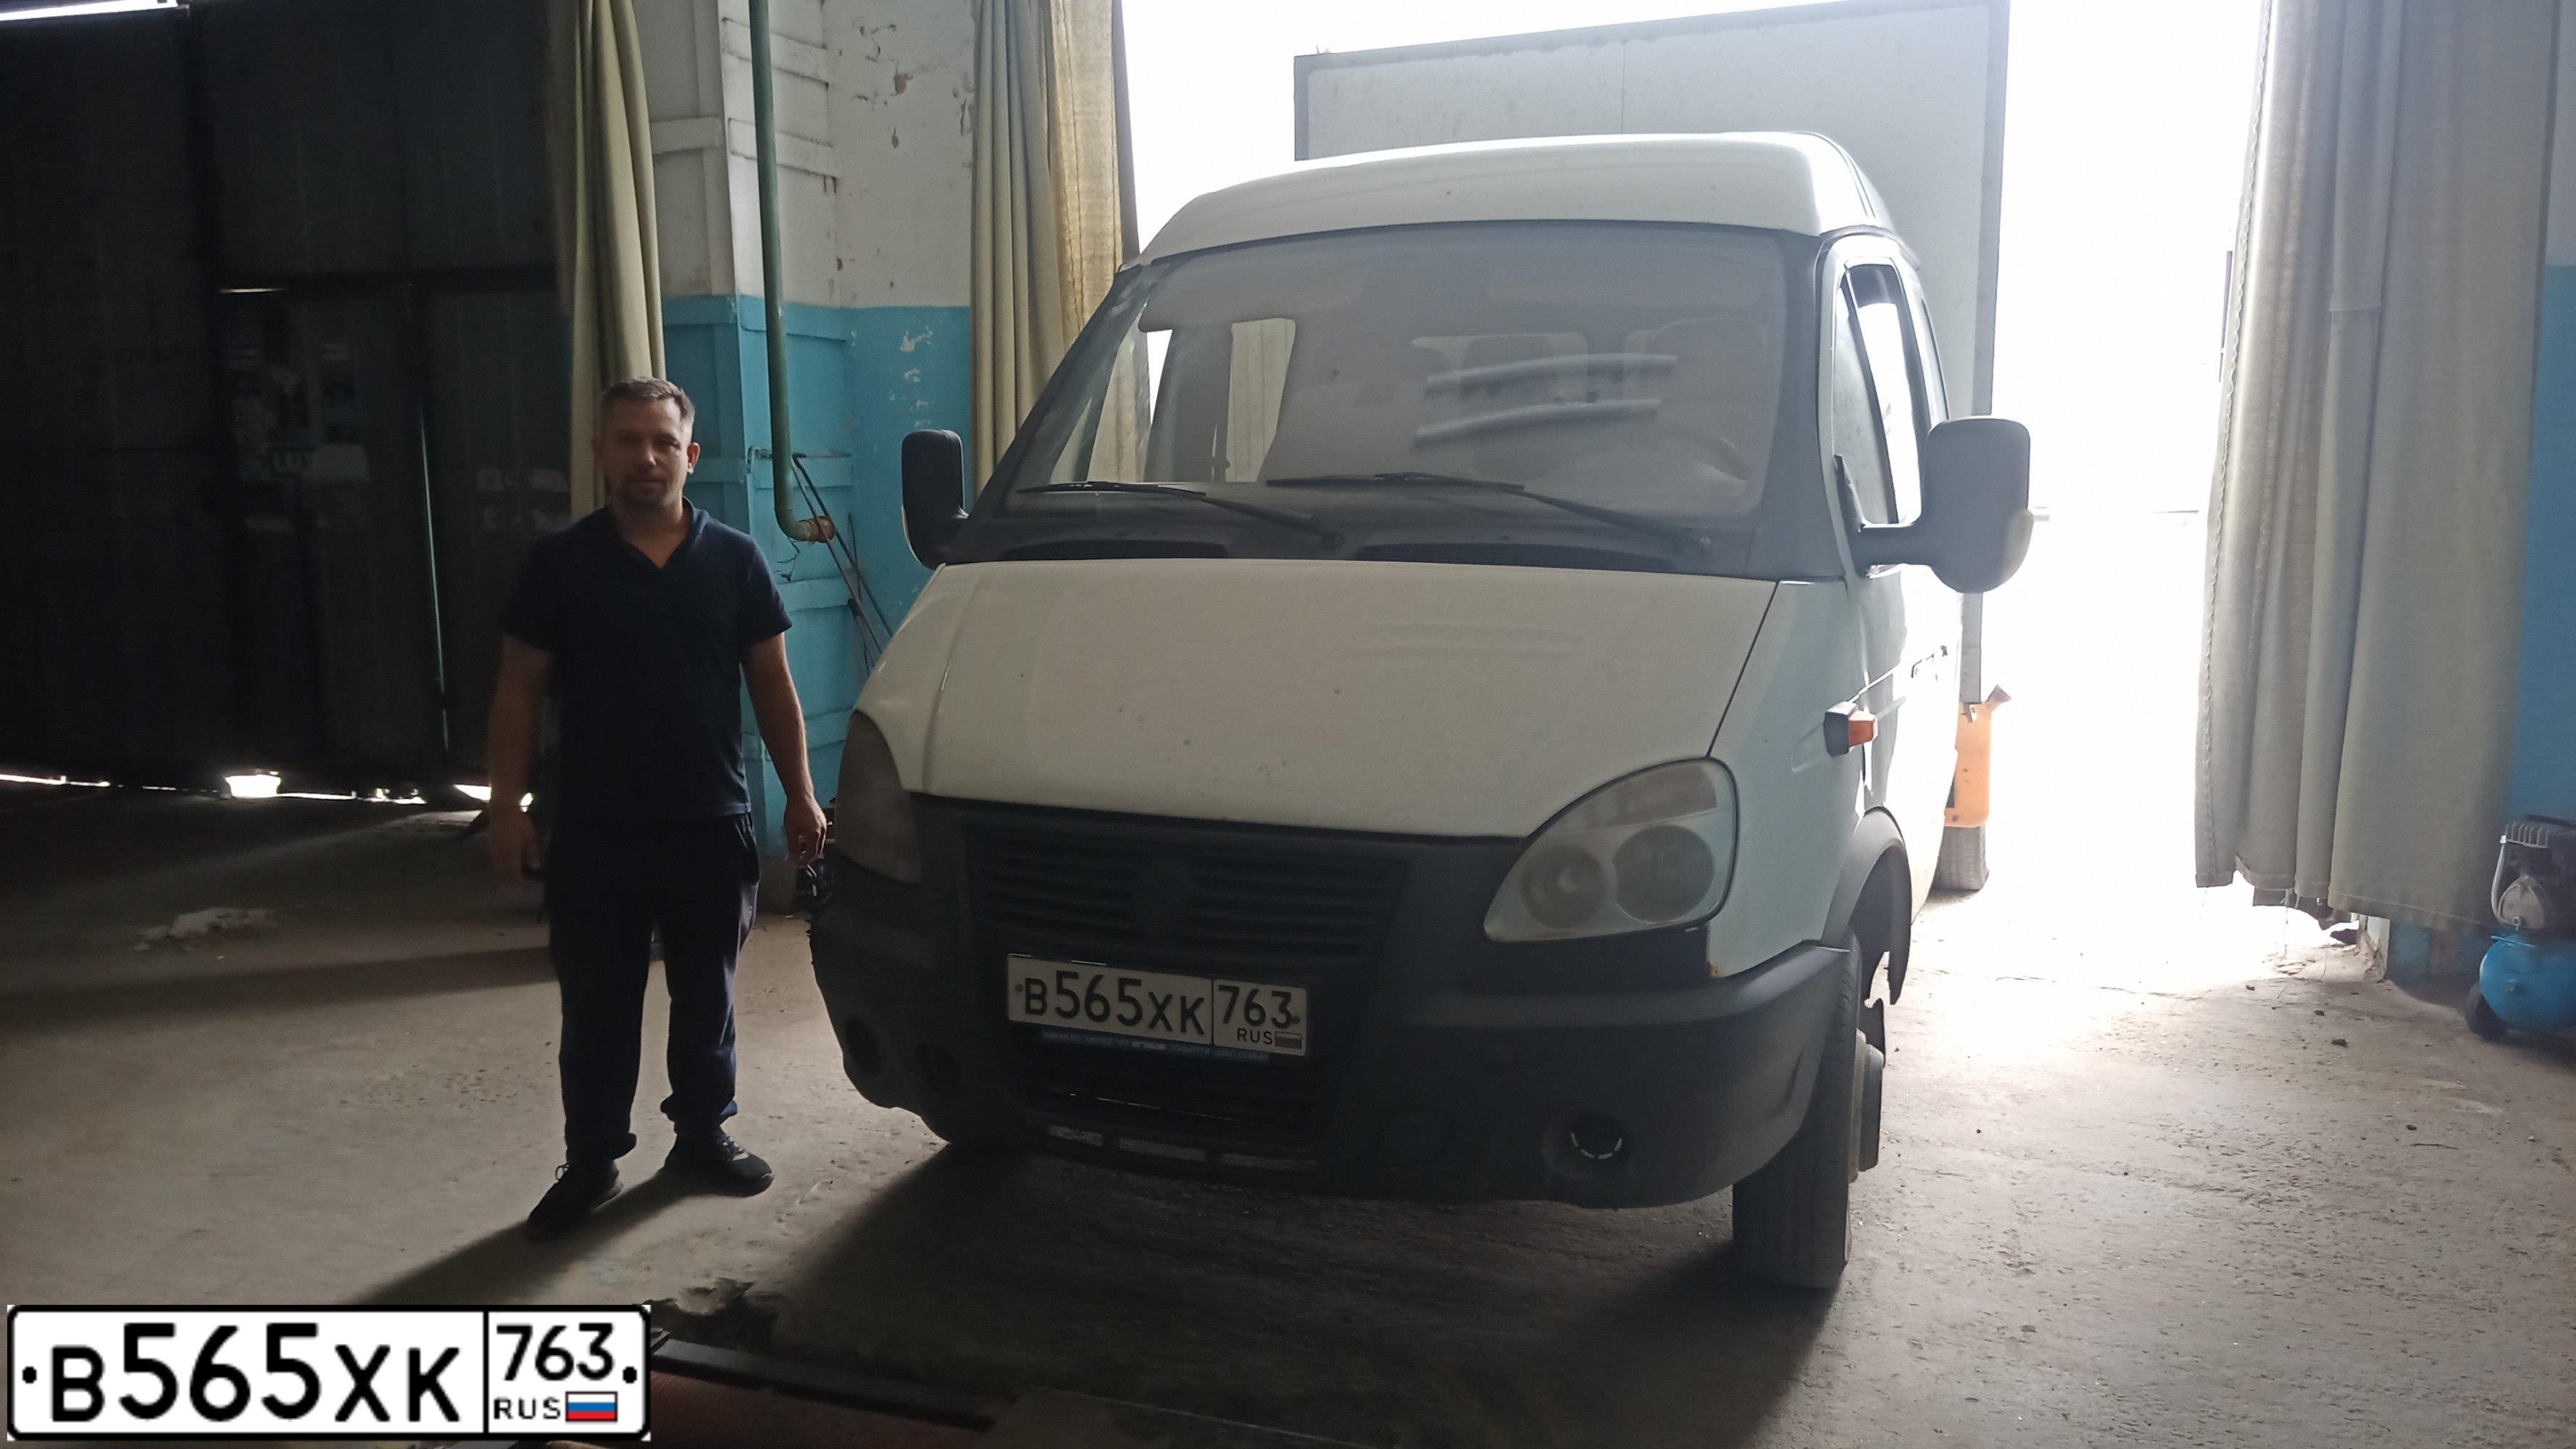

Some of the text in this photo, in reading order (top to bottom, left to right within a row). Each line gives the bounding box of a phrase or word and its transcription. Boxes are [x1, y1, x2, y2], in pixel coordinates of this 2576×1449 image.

[1024, 970, 1293, 1035] В565ХК 763
[1238, 1028, 1273, 1045] RUS
